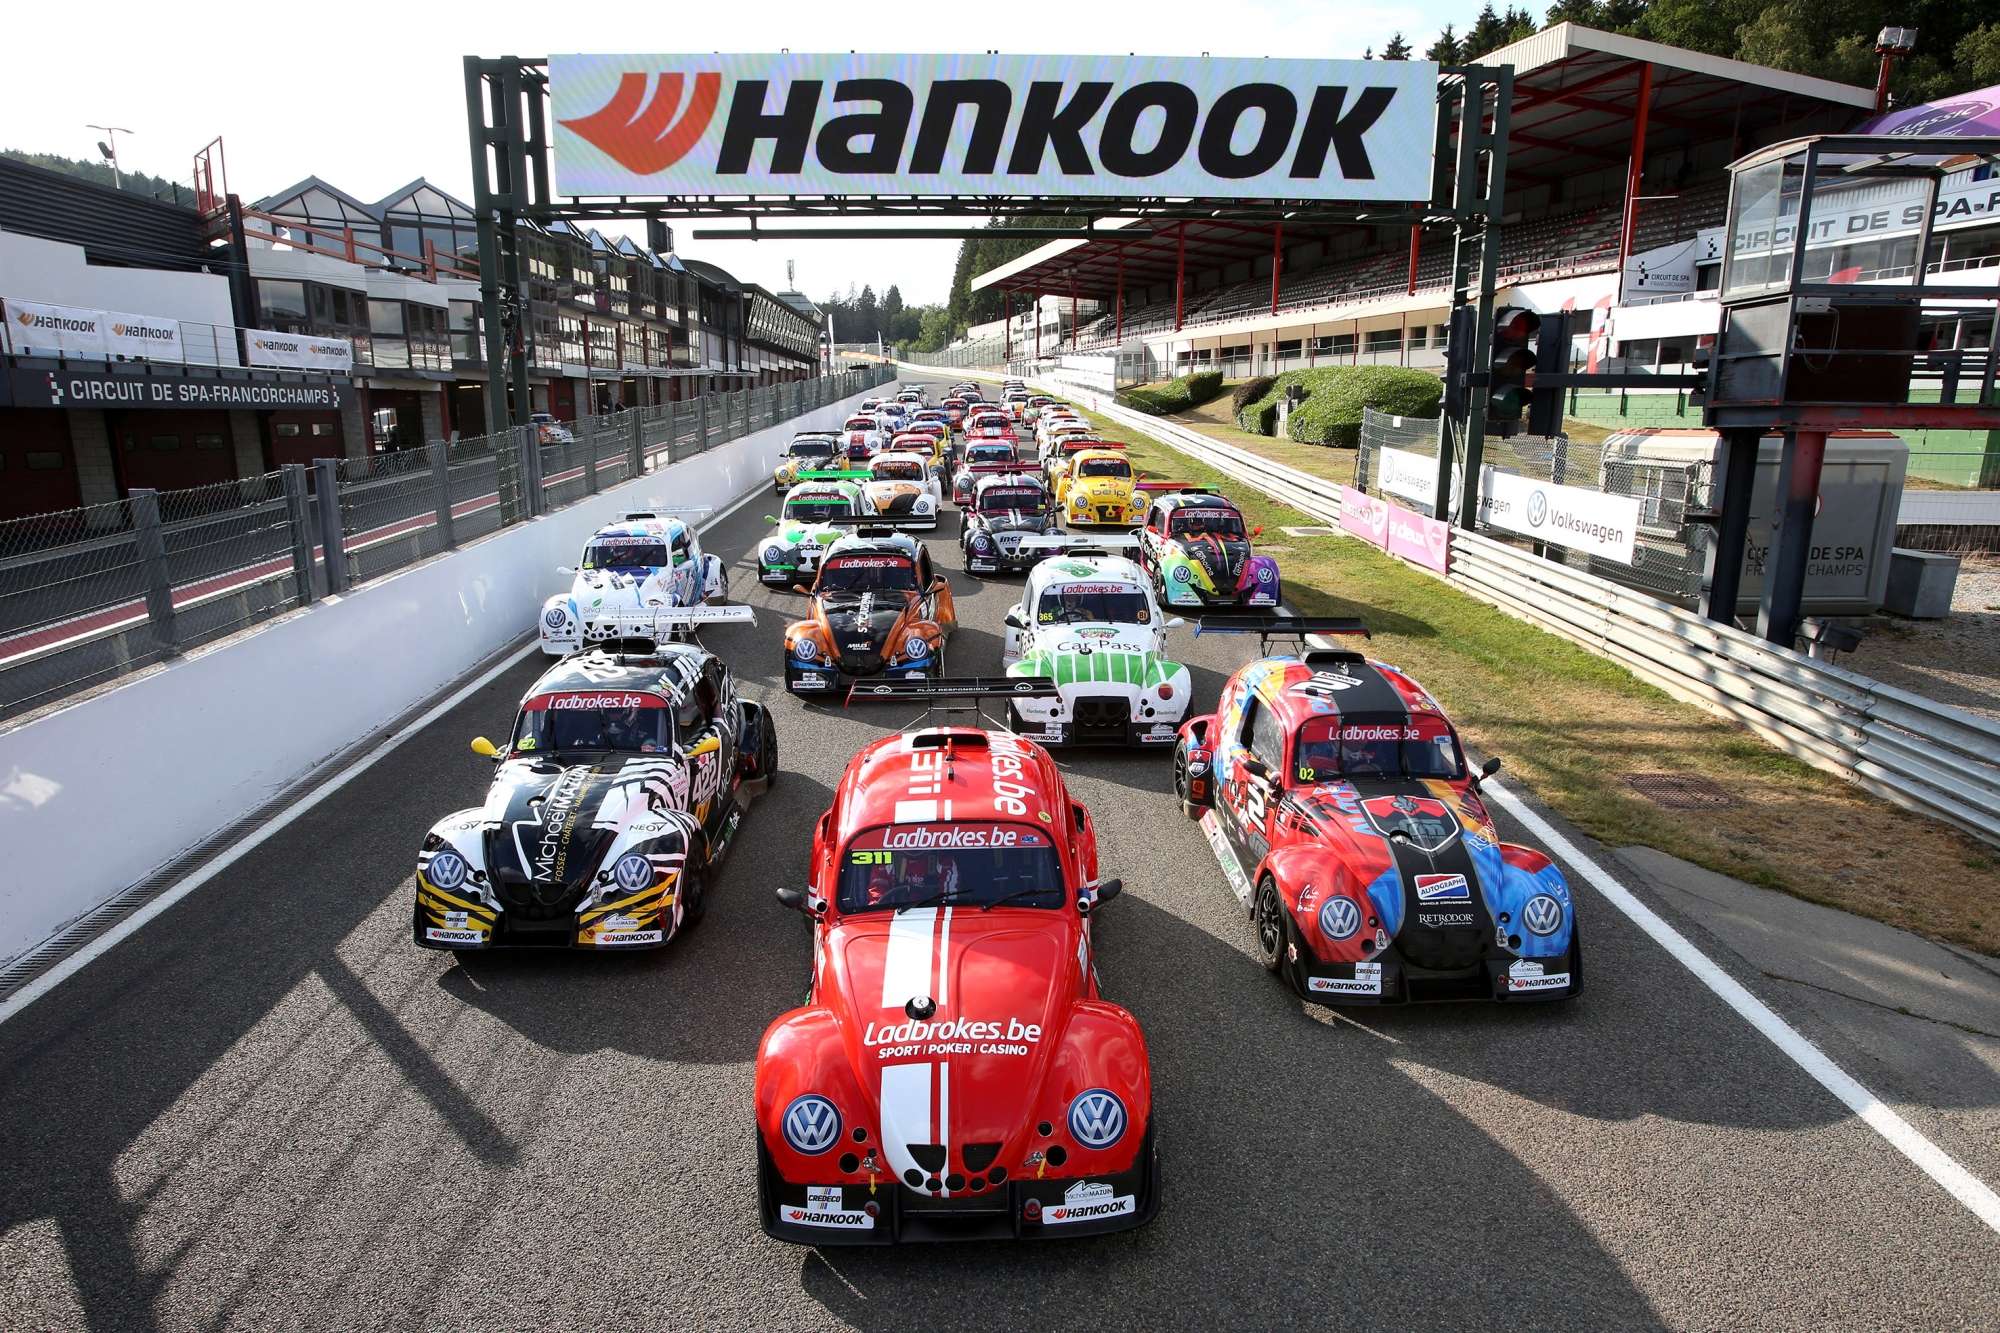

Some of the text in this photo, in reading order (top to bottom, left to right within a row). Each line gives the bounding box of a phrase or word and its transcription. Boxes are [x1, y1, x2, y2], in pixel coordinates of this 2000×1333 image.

[1891, 106, 1978, 134] CLASSIC
[716, 78, 1397, 181] HANKOOK
[1847, 211, 1890, 234] DE
[70, 380, 329, 404] CIRCUIT DE SPA-FRANCORCHAMPS
[1395, 469, 1431, 491] Volkswagen
[1477, 495, 1510, 514] swagen
[1551, 508, 1623, 543] Volkswagen
[601, 536, 652, 547] Ladbrokes.be
[1811, 547, 1864, 560] DE SPA
[840, 559, 898, 568] Ladbrokes.be
[1062, 584, 1123, 594] Ladbrokes.be
[1039, 613, 1053, 621] 365
[1057, 640, 1141, 652] Car-Pass
[548, 693, 642, 710] Ladbrokes.be
[1329, 726, 1419, 741] Ladbrokes.be
[693, 757, 717, 802] 422
[1299, 768, 1315, 781] 02
[673, 778, 686, 790] TOTAL
[1248, 782, 1267, 833] 2
[883, 826, 1017, 848] Ladbrokes.be
[555, 850, 567, 883] FOSSES
[562, 811, 578, 845] CHÂTELET
[851, 851, 892, 864] 311
[1421, 877, 1466, 895] AUTOGRAPHE
[1419, 914, 1473, 923] RETRODOR
[1325, 980, 1376, 991] HANKOOK
[1525, 976, 1567, 987] HANKOOK
[863, 1016, 1042, 1046] Ladbrokes.be
[878, 1043, 1028, 1058] SPORT POKER CASINO
[1066, 1200, 1127, 1218] HANKOOK
[803, 1212, 865, 1225] HANKOOK
